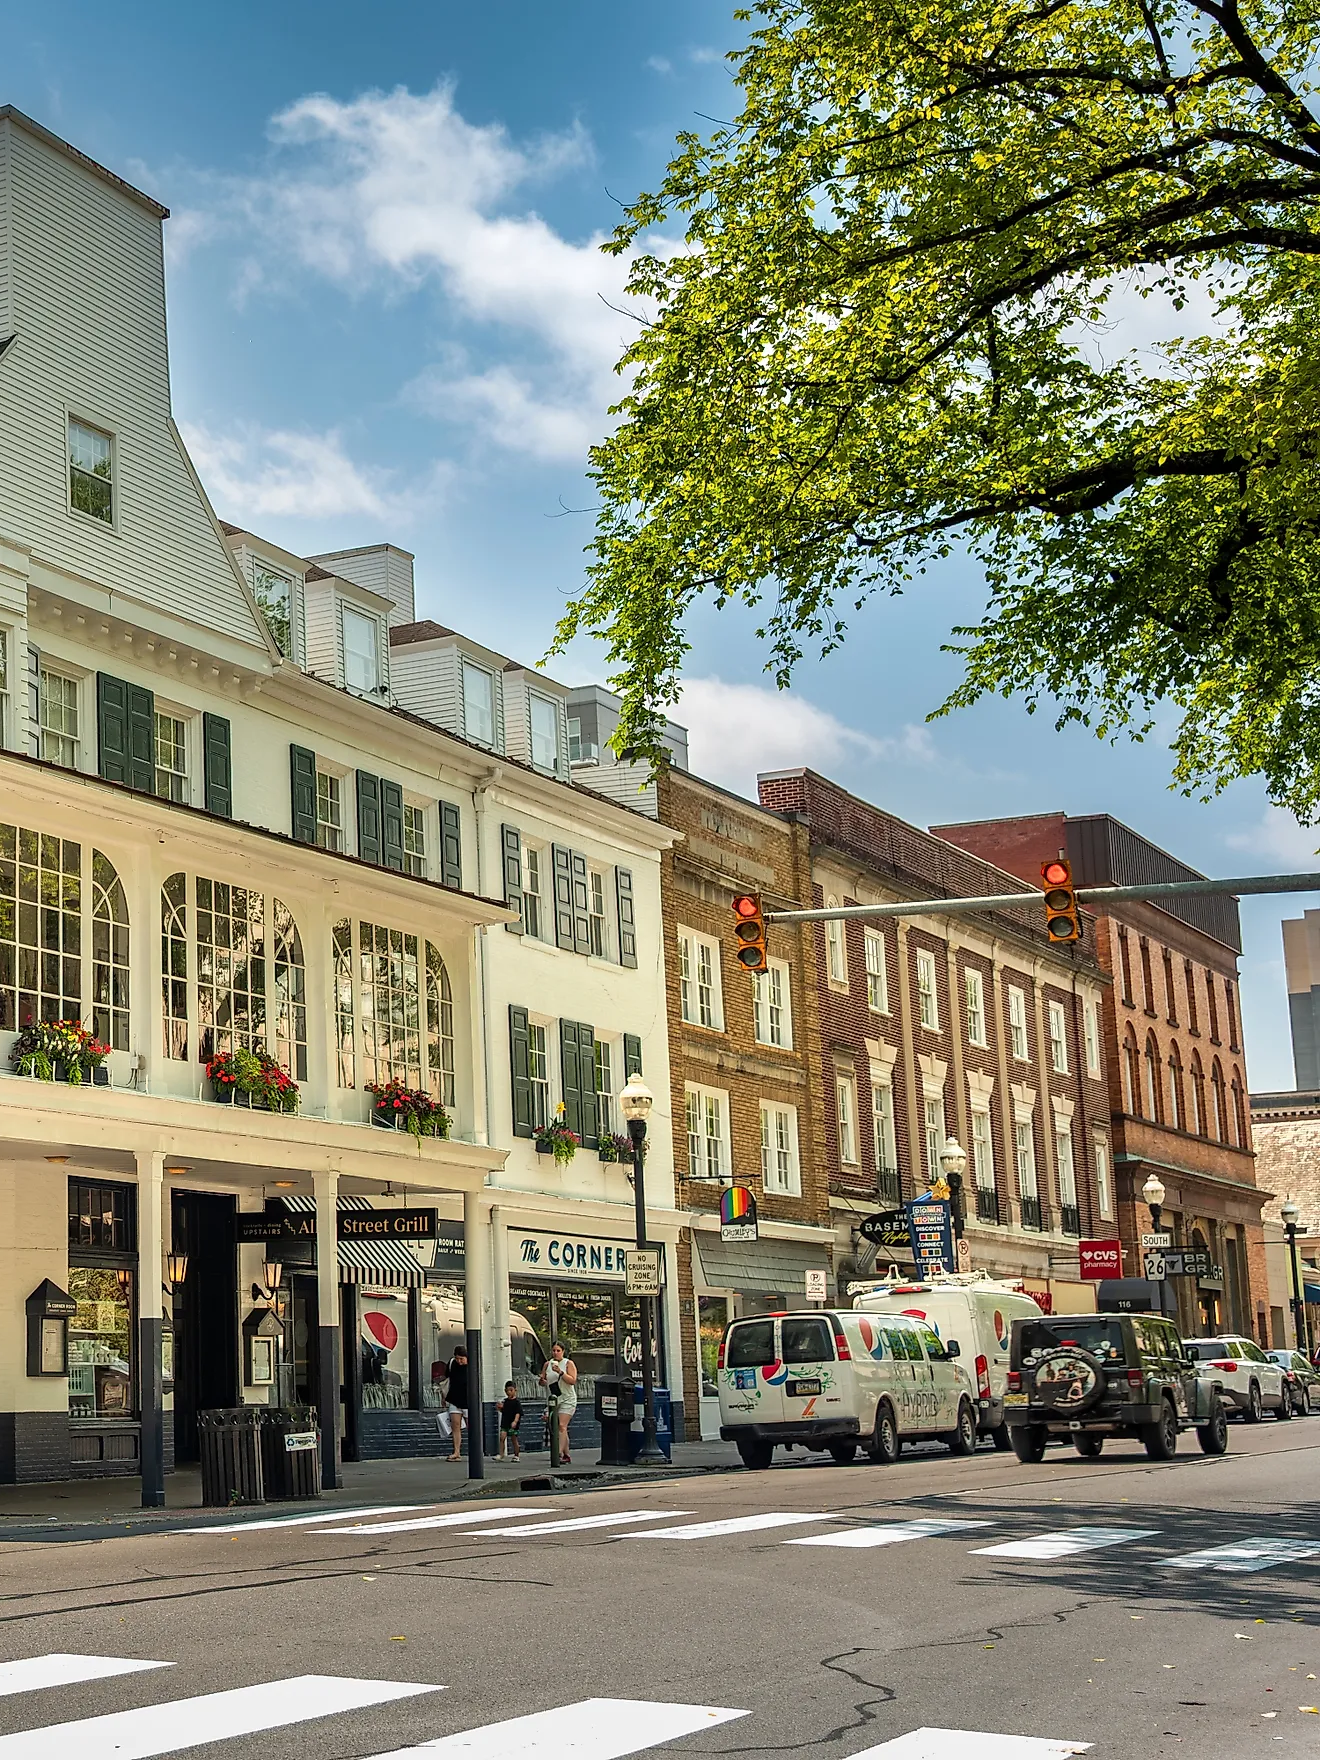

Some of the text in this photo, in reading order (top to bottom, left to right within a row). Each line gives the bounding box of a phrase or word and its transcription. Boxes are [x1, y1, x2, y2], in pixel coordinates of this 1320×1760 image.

[343, 1216, 429, 1233] Street Grill
[865, 1221, 909, 1232] BASEM
[243, 1228, 281, 1236] UPSTAIRS
[1143, 1236, 1168, 1245] SOUTH
[520, 1239, 626, 1272] The CORNER
[1093, 1250, 1118, 1261] CVS
[1184, 1254, 1206, 1263] BR
[628, 1263, 657, 1271] CRUISING
[1147, 1260, 1164, 1275] 26
[1185, 1264, 1208, 1273] GR
[634, 1272, 651, 1280] ZONE
[901, 1391, 938, 1418] HYBRID
